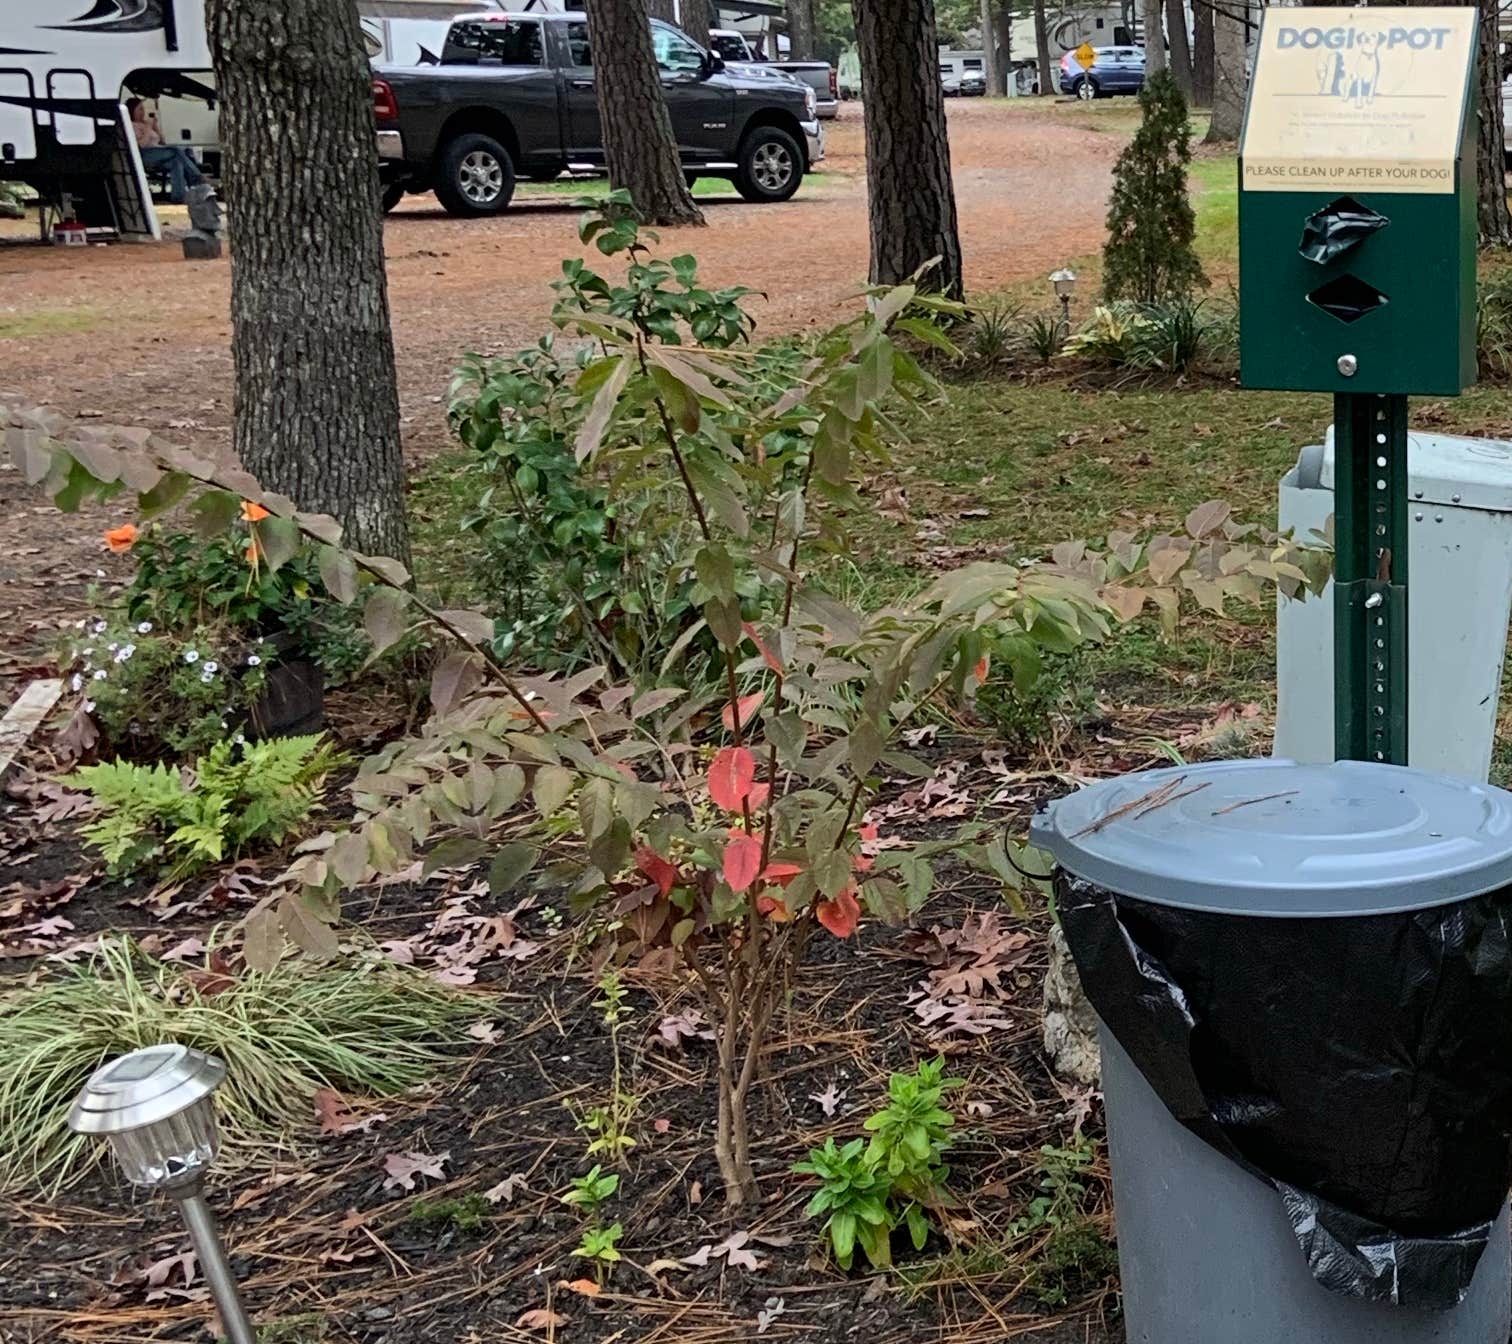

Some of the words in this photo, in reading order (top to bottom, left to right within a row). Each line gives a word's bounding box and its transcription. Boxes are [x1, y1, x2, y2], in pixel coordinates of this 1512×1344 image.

[1245, 166, 1285, 177] PLEASE
[1288, 166, 1326, 177] CLEAN
[1329, 167, 1345, 177] UP
[1347, 167, 1383, 178] AFTER
[1384, 167, 1418, 178] YOUR
